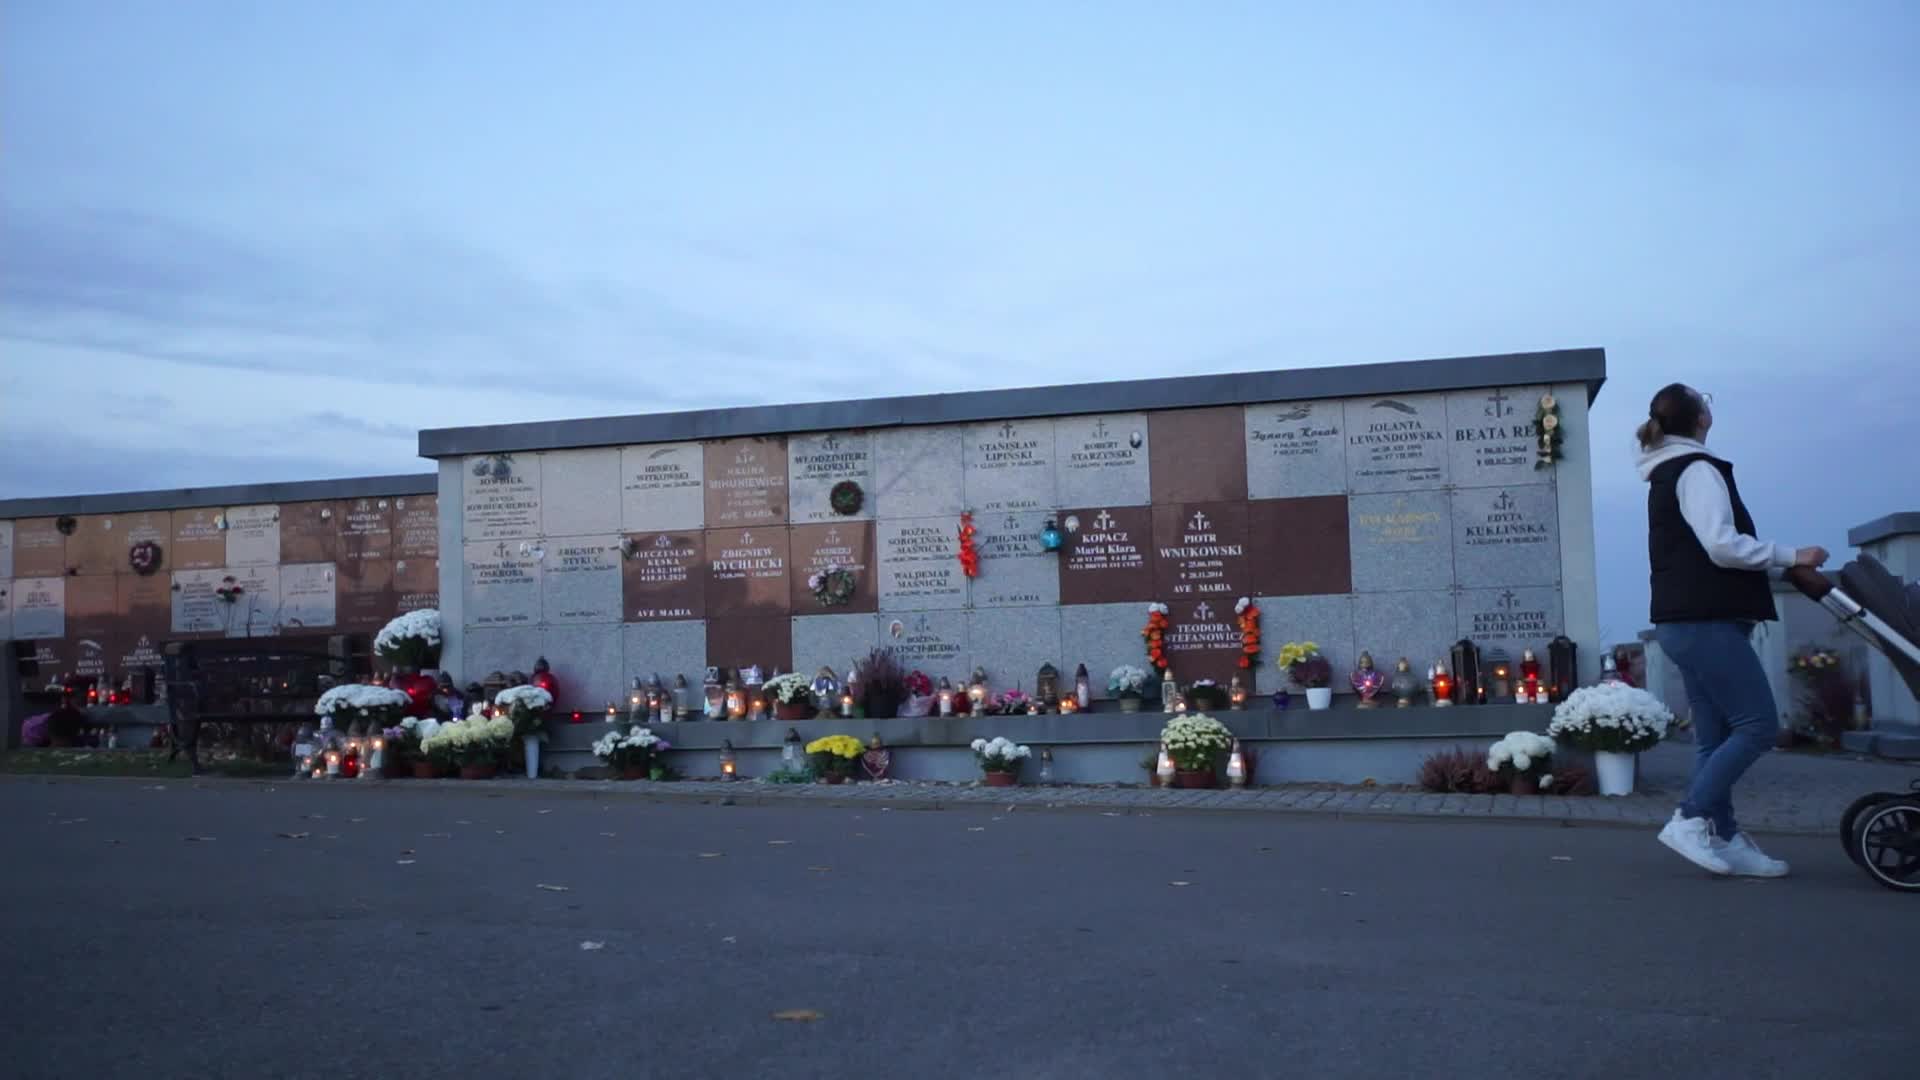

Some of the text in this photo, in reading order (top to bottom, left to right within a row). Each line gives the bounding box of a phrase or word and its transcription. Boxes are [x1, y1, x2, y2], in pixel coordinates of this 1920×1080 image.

[1368, 421, 1422, 433] JOLANTA
[1350, 432, 1443, 444] LEWANDOWSKA
[1455, 428, 1506, 441] BEATA
[979, 441, 1039, 451] STANISŁAW
[1083, 442, 1118, 450] ROBERT
[795, 452, 867, 464] WŁODZIMIERZ
[1487, 513, 1523, 523] EDYTA
[901, 527, 940, 536] BOŻENA
[1466, 524, 1546, 536] KUKLIŃSKA
[985, 534, 1040, 543] ZBIGNIEW
[1082, 532, 1128, 543] KOPACZ
[1184, 533, 1217, 543] PIOTR
[558, 547, 604, 556] ZBIGNIEW
[996, 544, 1028, 552] WYKA
[1075, 544, 1136, 555] Maria Klara
[1160, 546, 1242, 558] WNUKOWSKI
[721, 548, 772, 559] ZBIGNIEW
[712, 558, 782, 571] RYCHLICKI
[895, 569, 950, 578] WALDEMAR
[1173, 583, 1232, 593] AVE MARIA
[1473, 612, 1545, 622] KRZYSZTOF
[1176, 624, 1231, 633] TEODORA
